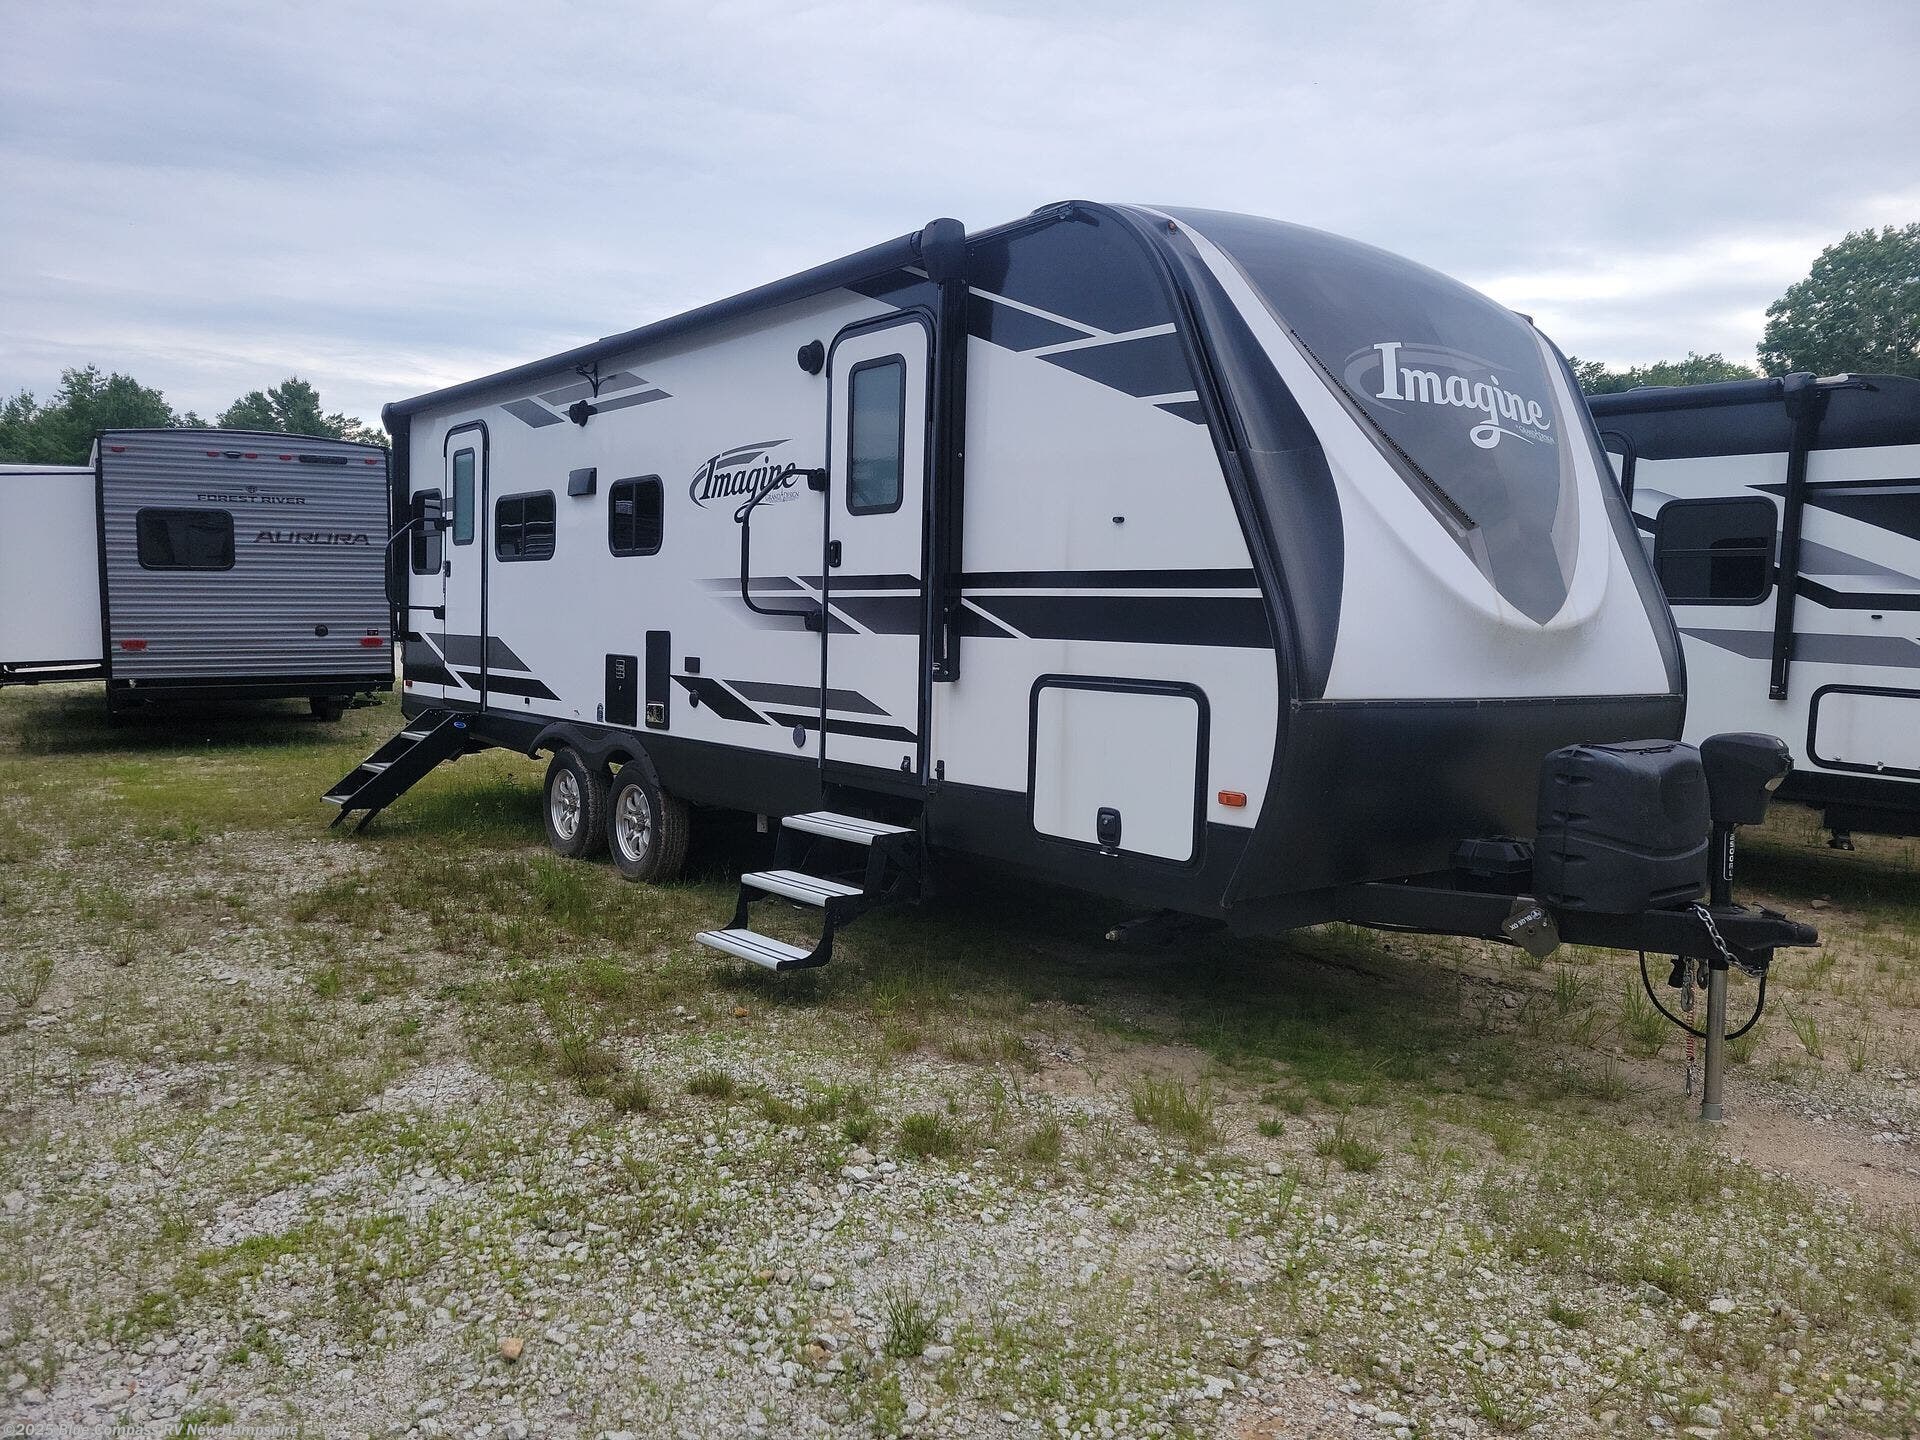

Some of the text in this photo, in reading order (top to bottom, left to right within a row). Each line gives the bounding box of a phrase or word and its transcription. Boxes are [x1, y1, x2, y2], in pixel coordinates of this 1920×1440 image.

[1373, 341, 1551, 450] Imagine
[197, 494, 306, 505] FOREST RIVER
[698, 453, 800, 524] Imagine
[252, 531, 371, 546] AURORA
